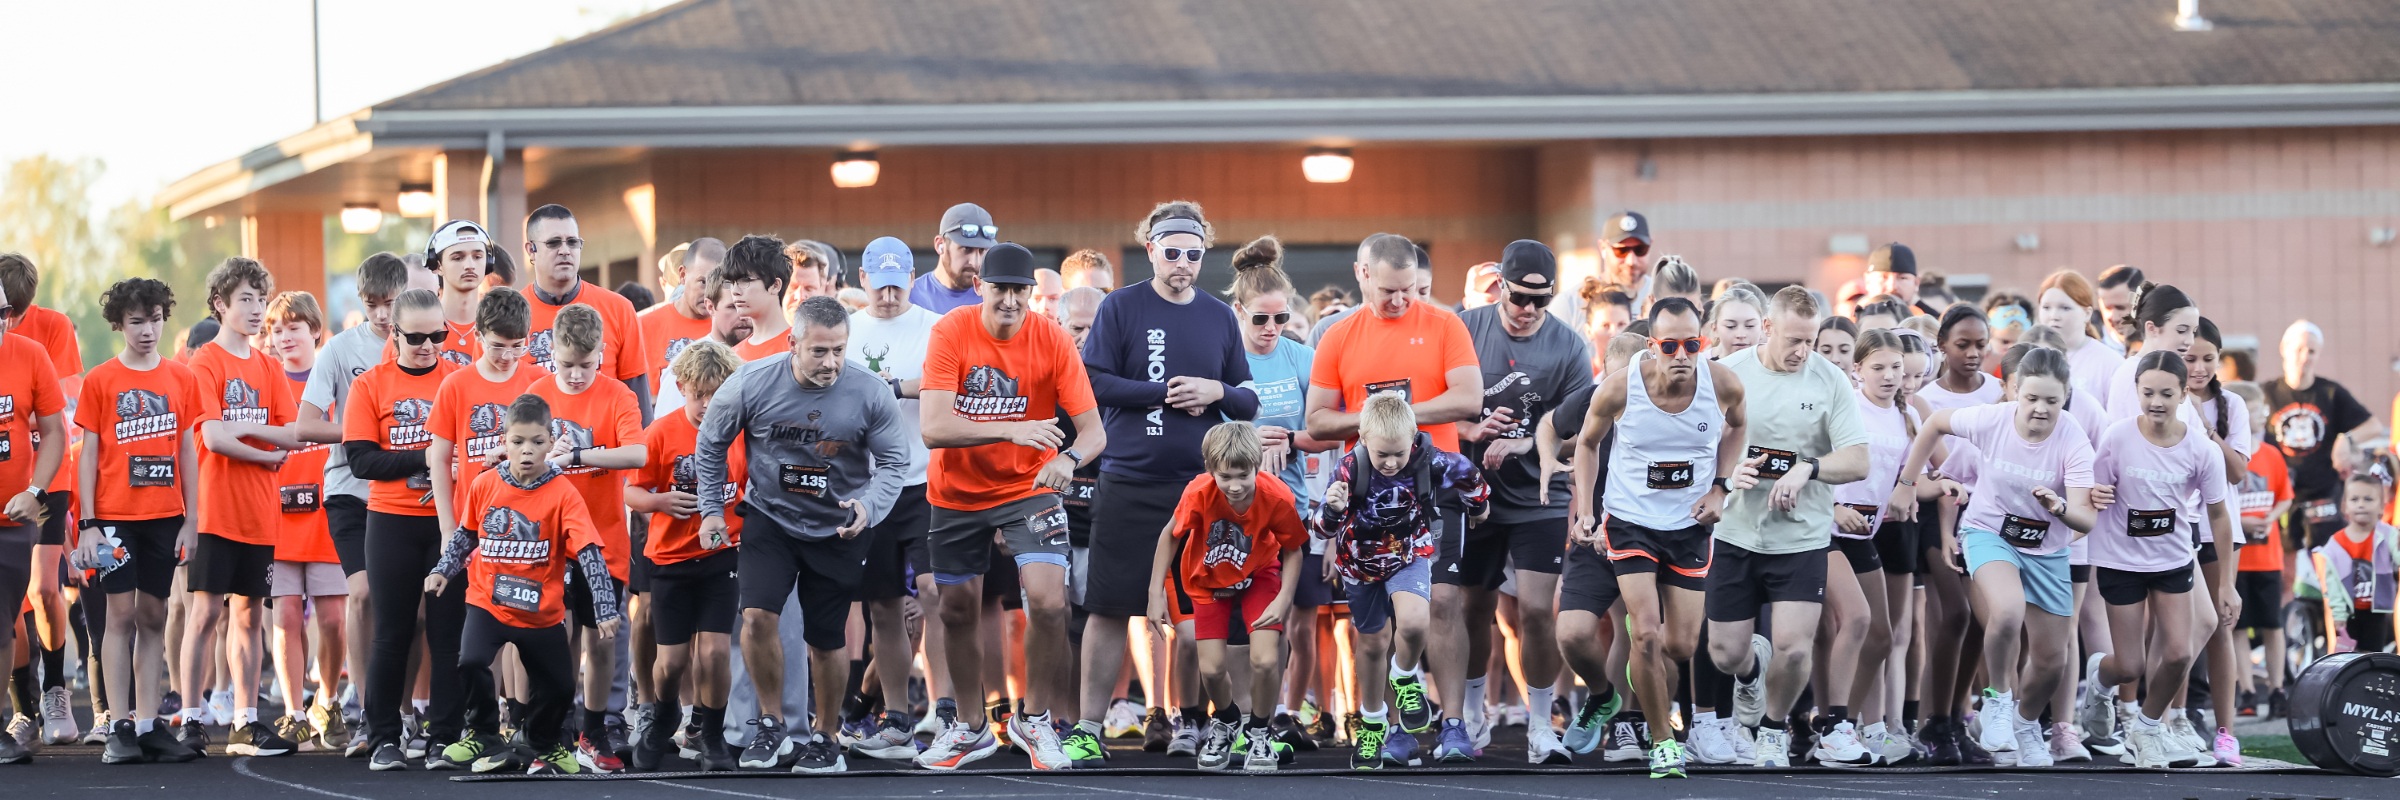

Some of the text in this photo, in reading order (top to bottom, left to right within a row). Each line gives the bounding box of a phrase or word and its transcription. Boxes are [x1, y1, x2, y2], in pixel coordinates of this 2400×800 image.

[1146, 344, 1166, 426] AON
[956, 399, 1025, 410] BULLDOG DASH
[116, 420, 155, 435] BULLDOG
[770, 424, 824, 443] TURKEY
[1146, 426, 1163, 436] 13.1
[1771, 457, 1789, 471] 95
[149, 464, 174, 478] 271
[1671, 469, 1689, 482] 64
[800, 475, 827, 489] 135
[297, 492, 314, 505] 85
[2151, 518, 2170, 529] 78
[2020, 528, 2046, 540] 224
[523, 546, 548, 554] DASH
[512, 587, 539, 604] 103
